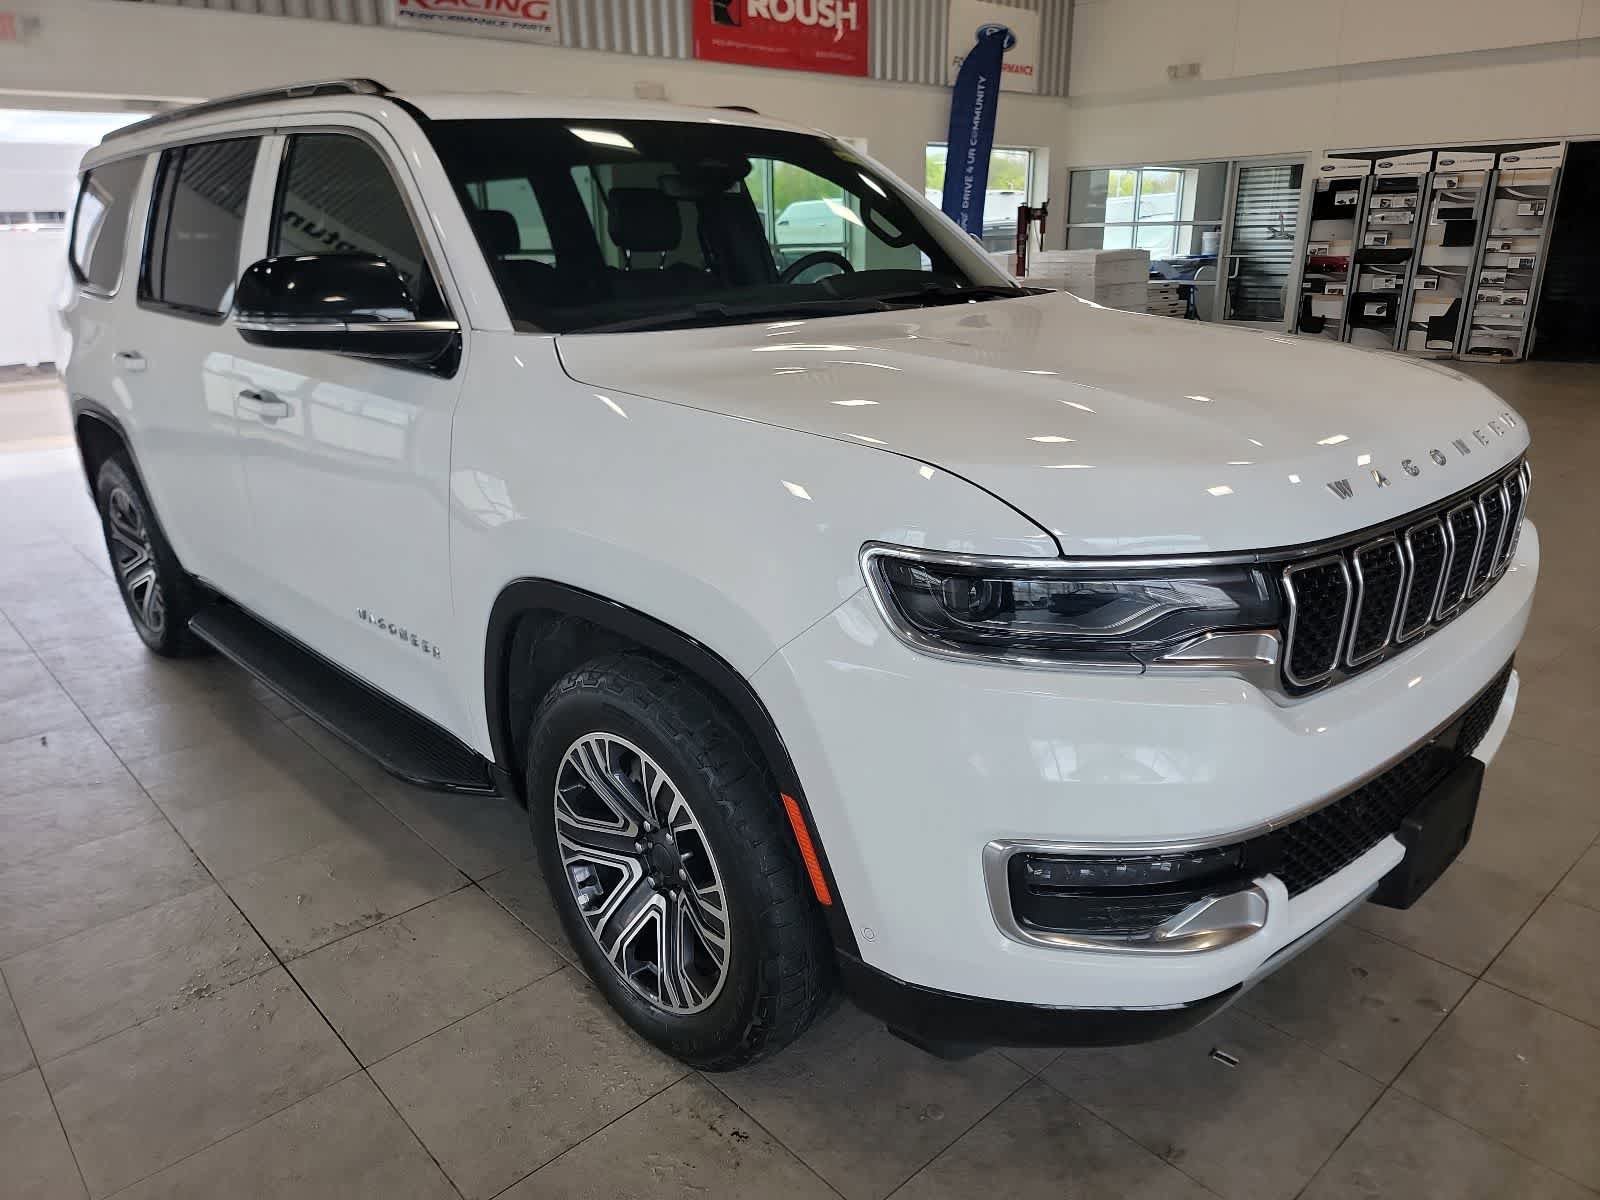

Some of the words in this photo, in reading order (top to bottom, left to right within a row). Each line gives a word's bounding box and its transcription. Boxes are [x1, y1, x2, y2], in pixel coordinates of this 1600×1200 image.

[747, 0, 857, 42] ROUSH
[962, 175, 974, 209] DRIVE
[969, 75, 987, 146] COMMUNITY
[1326, 412, 1517, 500] WAGONEER
